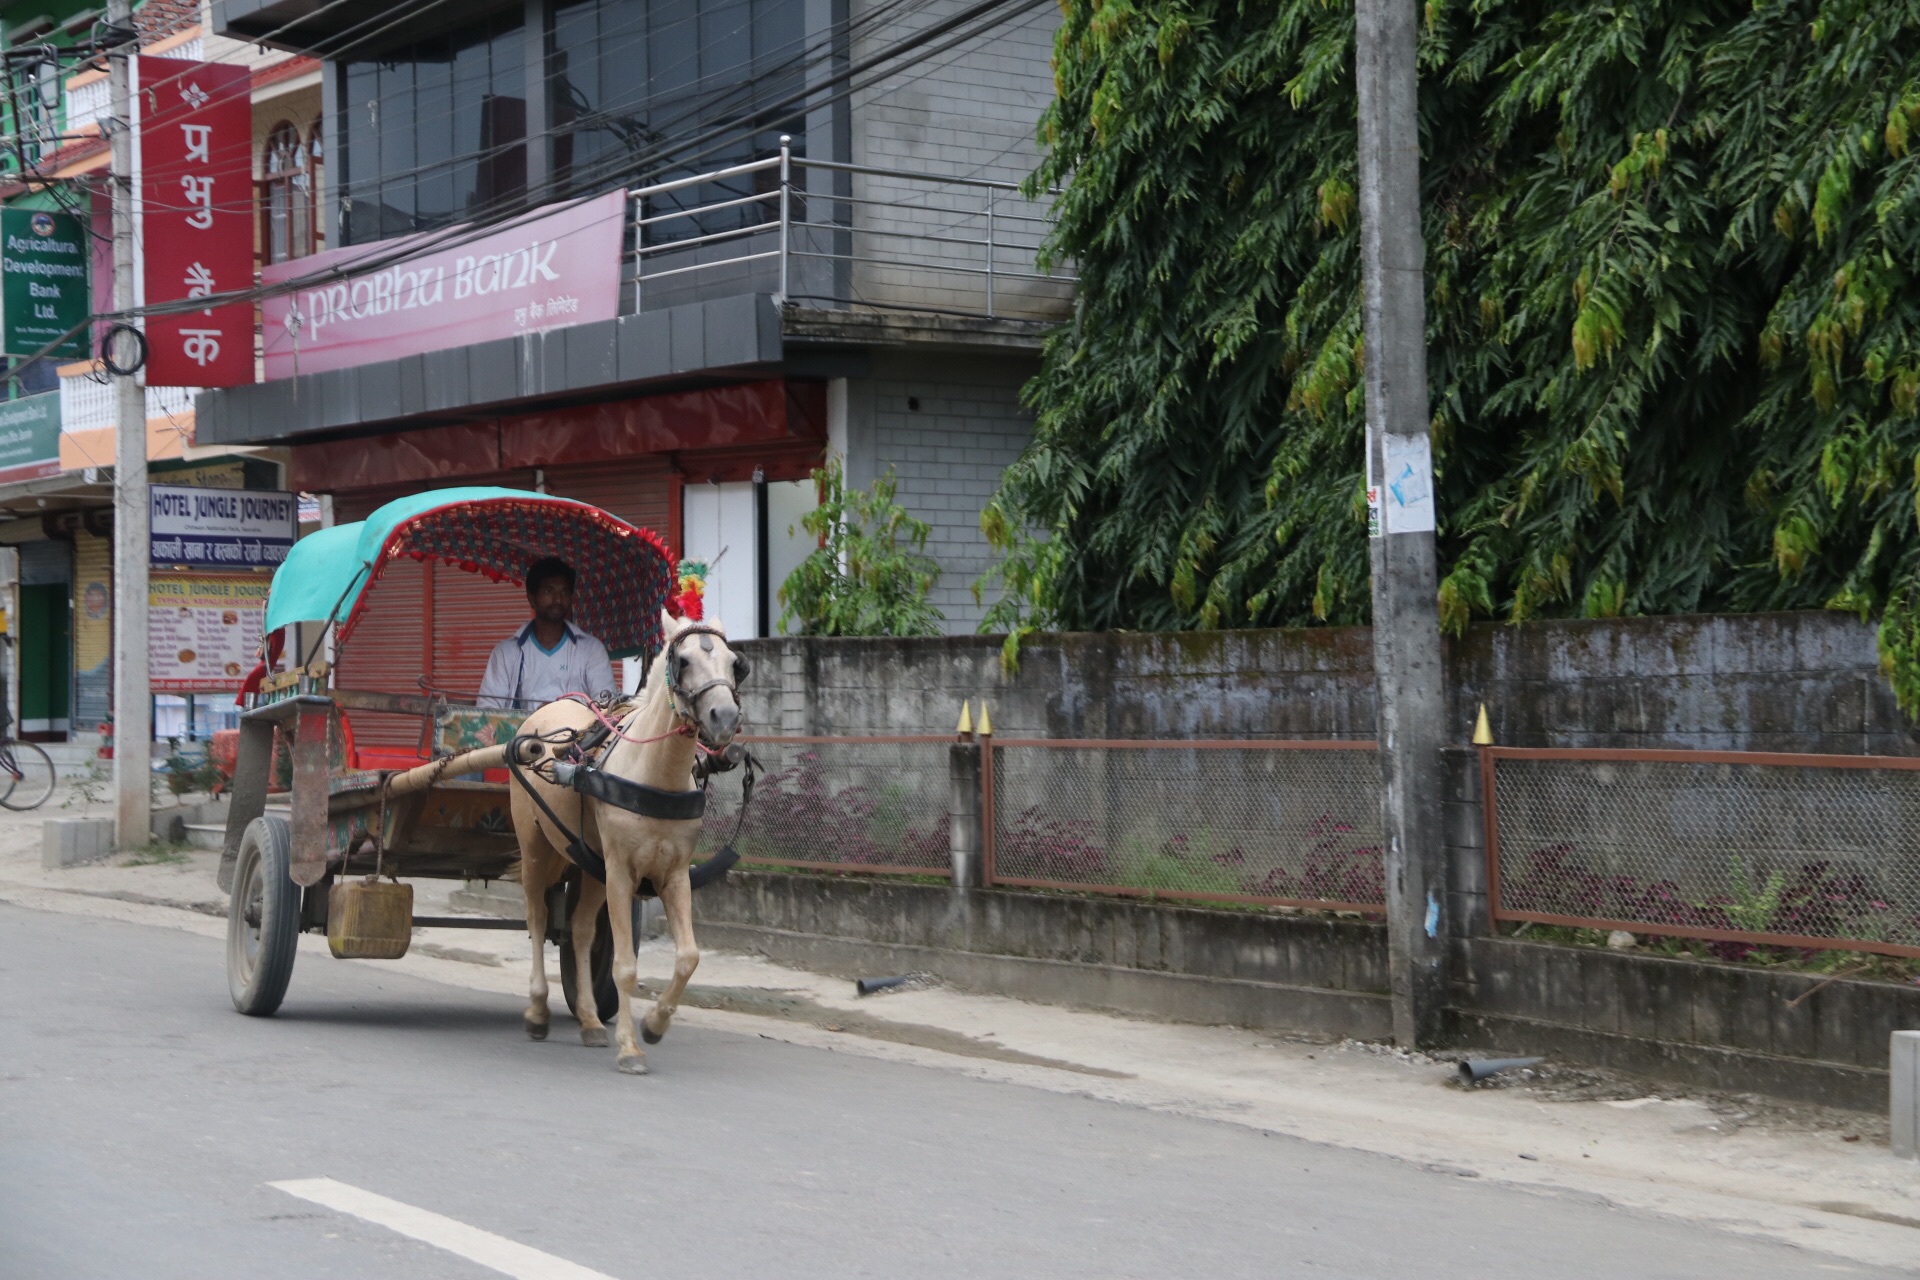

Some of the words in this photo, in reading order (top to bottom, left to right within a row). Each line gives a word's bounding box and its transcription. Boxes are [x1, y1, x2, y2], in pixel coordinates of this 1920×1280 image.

[3, 257, 85, 278] Development
[29, 282, 61, 298] Bank
[34, 303, 58, 319] Ltd.
[153, 493, 191, 517] HOTEL
[194, 495, 237, 521] JUNGLE
[240, 497, 290, 523] JOURNEY
[149, 583, 185, 594] HOTEL
[189, 584, 229, 597] JUNGLE
